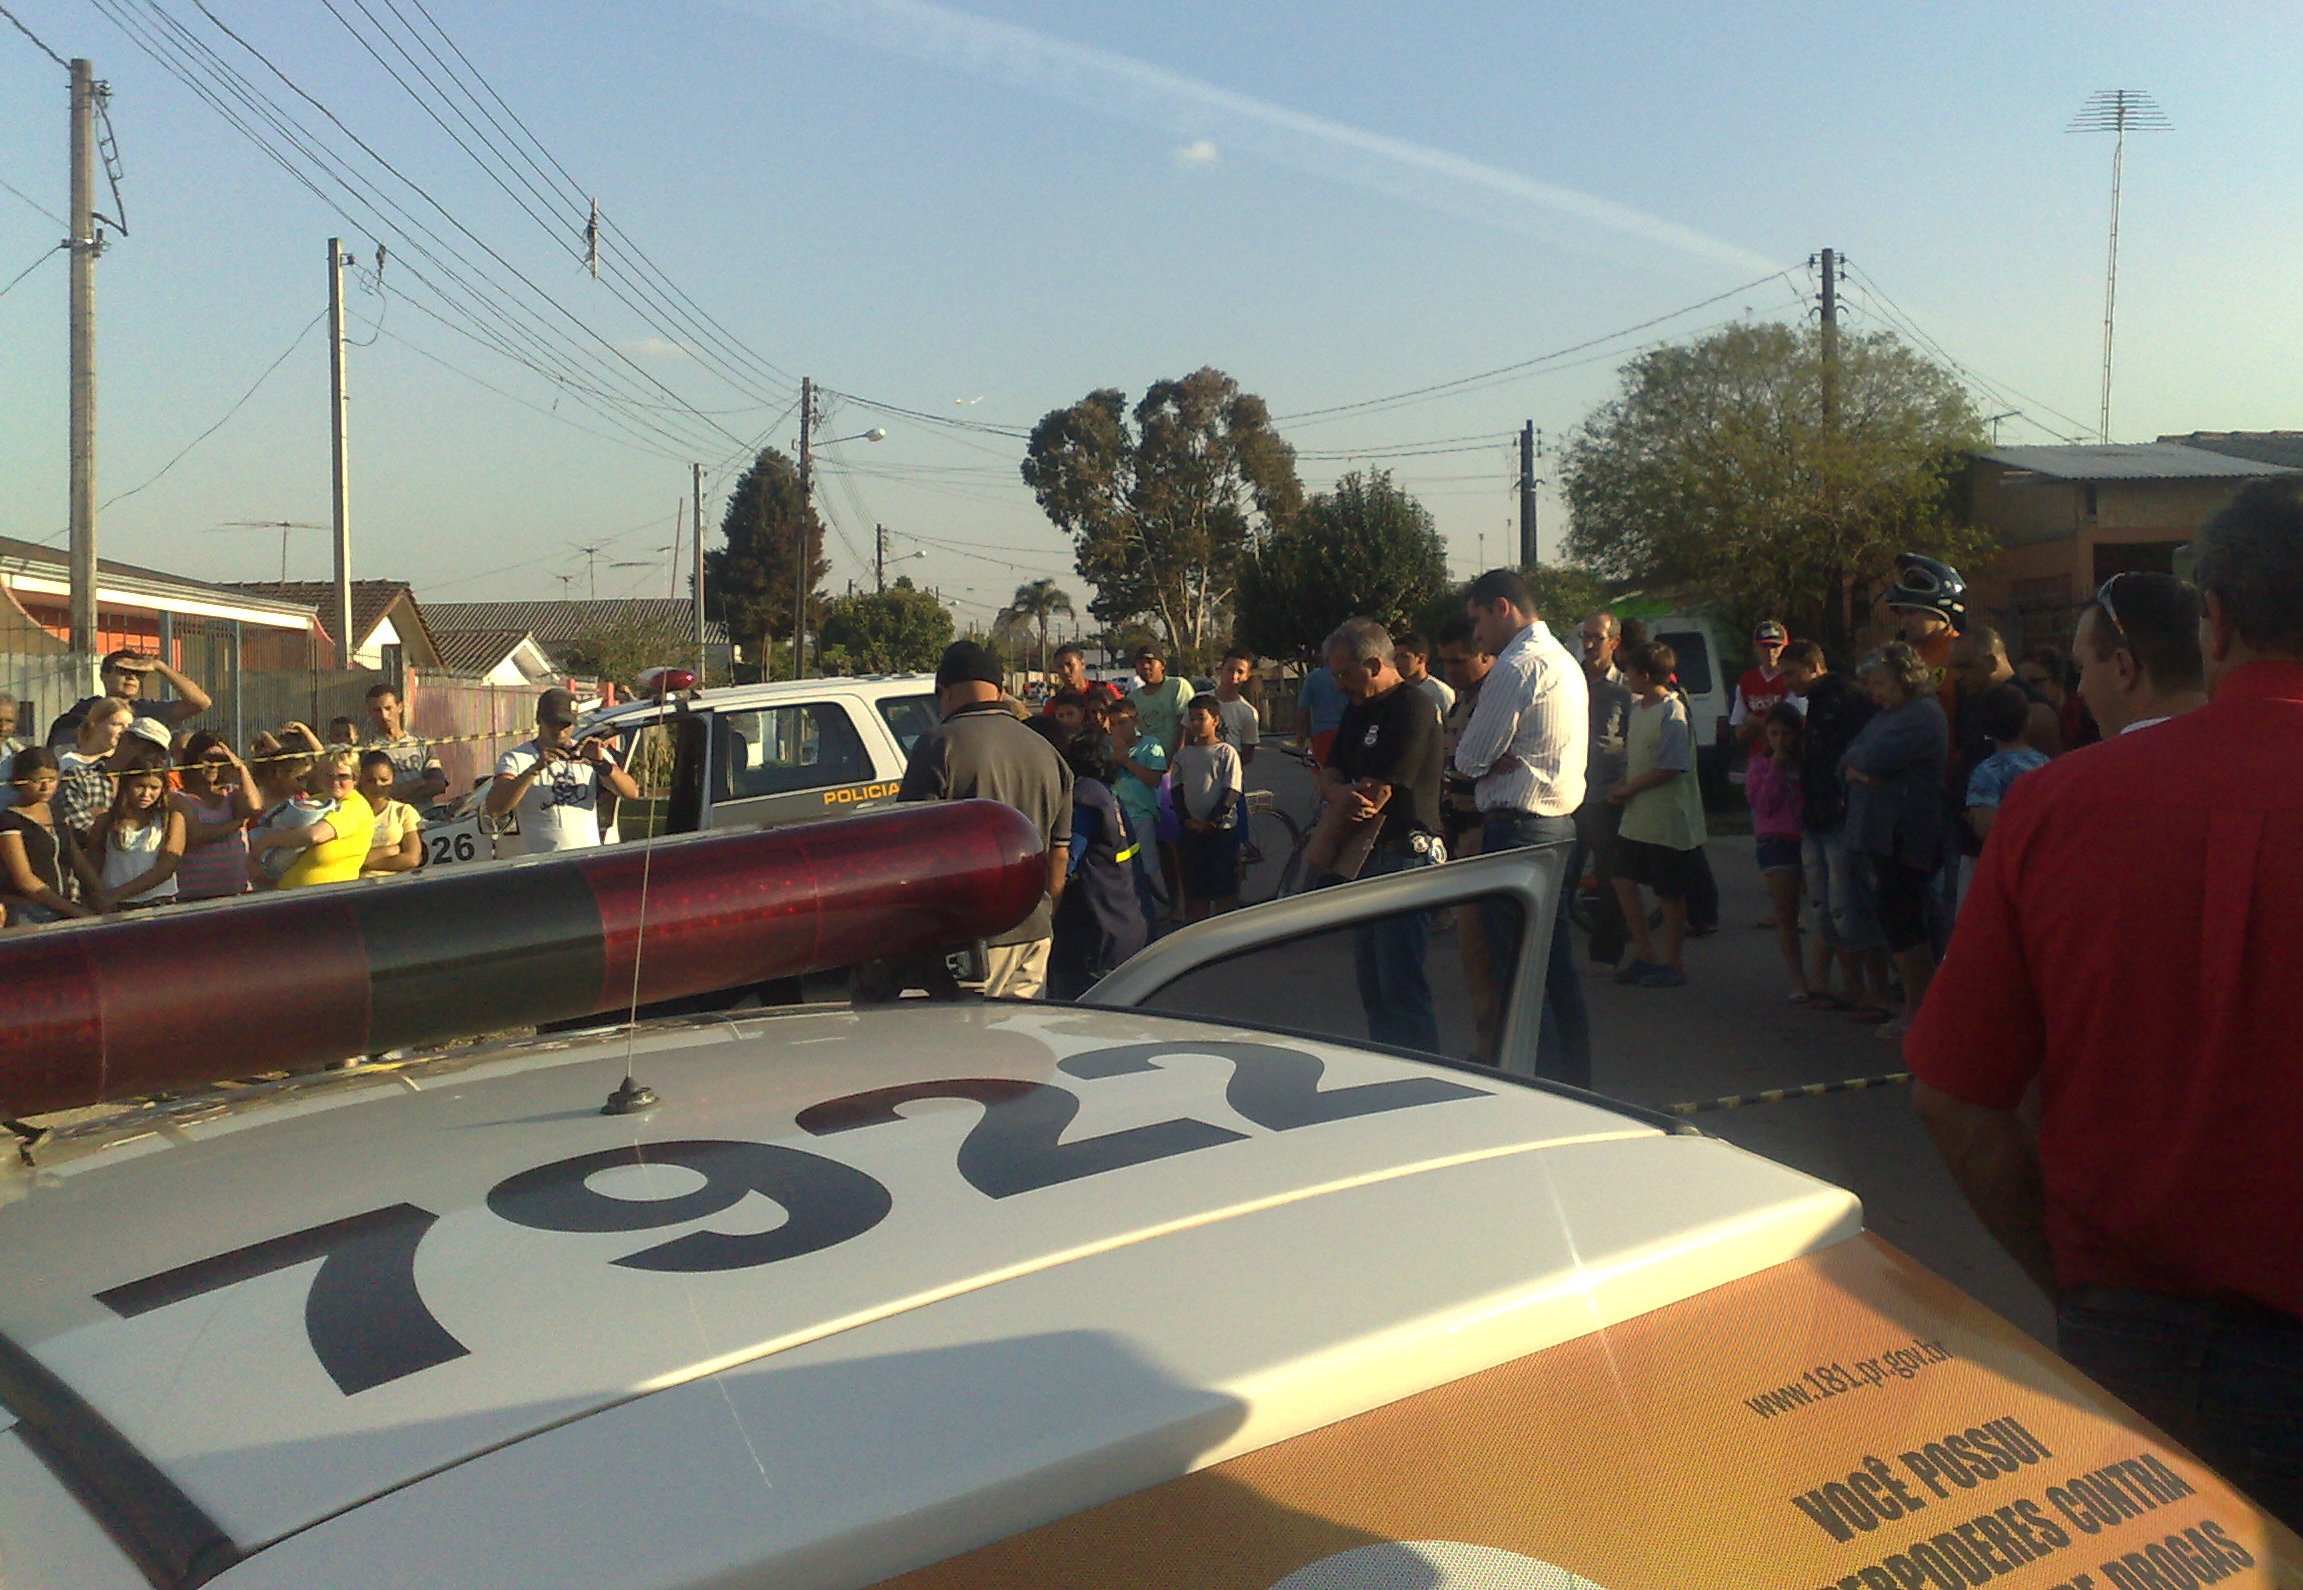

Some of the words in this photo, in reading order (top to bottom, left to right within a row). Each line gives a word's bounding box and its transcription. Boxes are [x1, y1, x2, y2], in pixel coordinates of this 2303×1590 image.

[823, 782, 901, 805] POLICIA
[93, 1040, 1494, 1396] 7922
[1743, 1339, 1954, 1419] www.181.pr.gov.br
[1792, 1455, 1926, 1543] VOCÊ
[1899, 1416, 2052, 1499] POSSUI
[1818, 1500, 2071, 1590] PODERES
[2045, 1453, 2197, 1534] CONTRA
[2100, 1520, 2255, 1590] DROGAS
